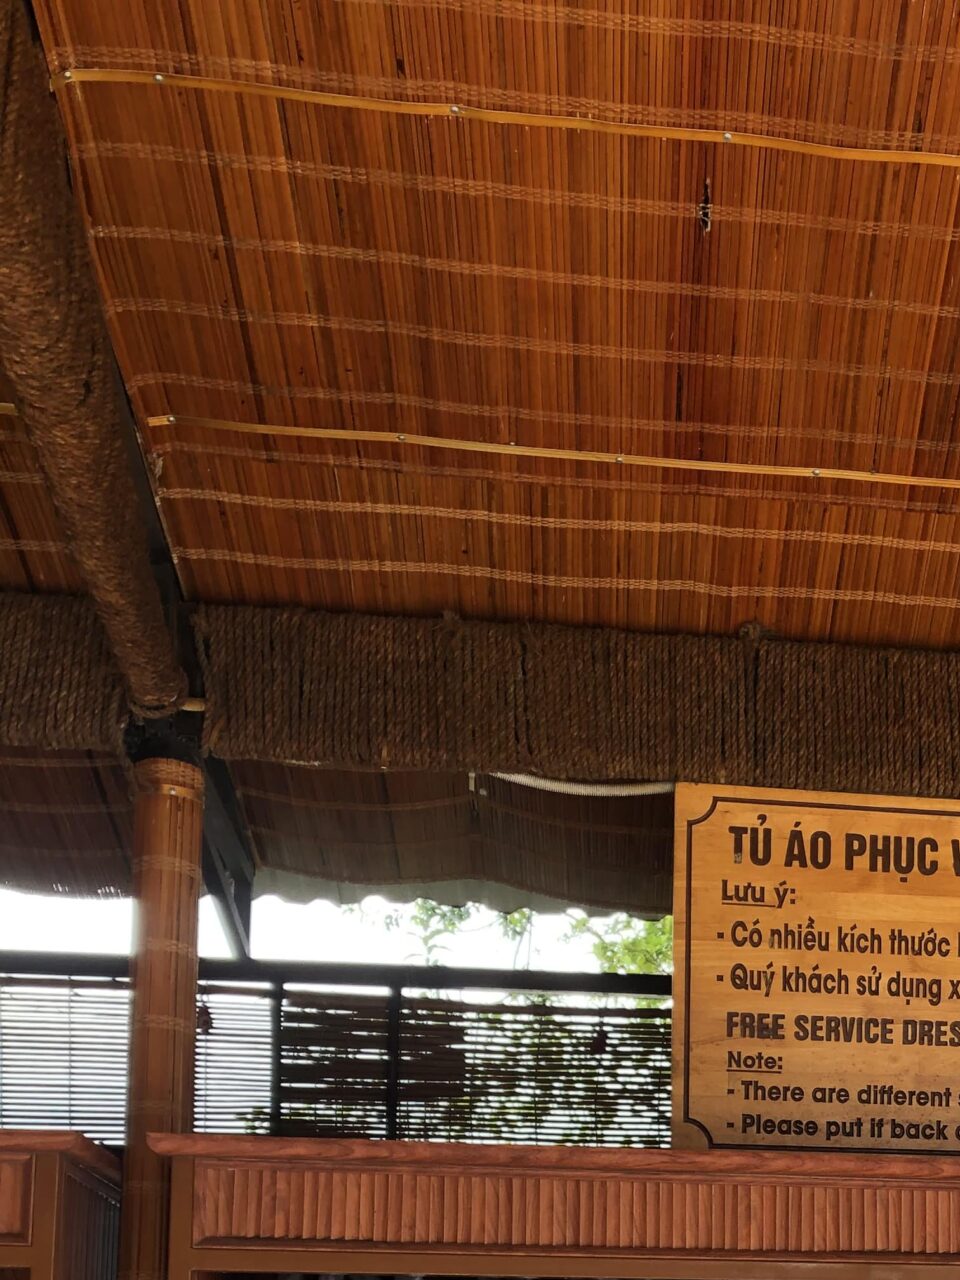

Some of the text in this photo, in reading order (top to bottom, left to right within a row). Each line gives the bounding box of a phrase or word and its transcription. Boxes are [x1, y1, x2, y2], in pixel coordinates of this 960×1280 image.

[728, 814, 772, 866] TỦ
[784, 821, 832, 870] ÁO
[844, 832, 939, 883] PHỤC
[721, 879, 796, 909] Lưu ý:
[730, 918, 763, 948] Có
[768, 916, 830, 952] nhiều
[837, 923, 882, 955] kích
[889, 927, 951, 958] thước
[730, 961, 776, 998] Quý
[781, 963, 849, 995] khách
[856, 965, 882, 996] sử
[887, 970, 942, 1006] dụng
[726, 1011, 786, 1040] FREE
[793, 1014, 895, 1045] SERVICE
[726, 1050, 784, 1071] Note:
[740, 1080, 805, 1103] There
[811, 1085, 850, 1104] are
[857, 1084, 952, 1108] different
[740, 1113, 819, 1137] Please
[825, 1116, 864, 1141] put
[890, 1118, 949, 1141] back
